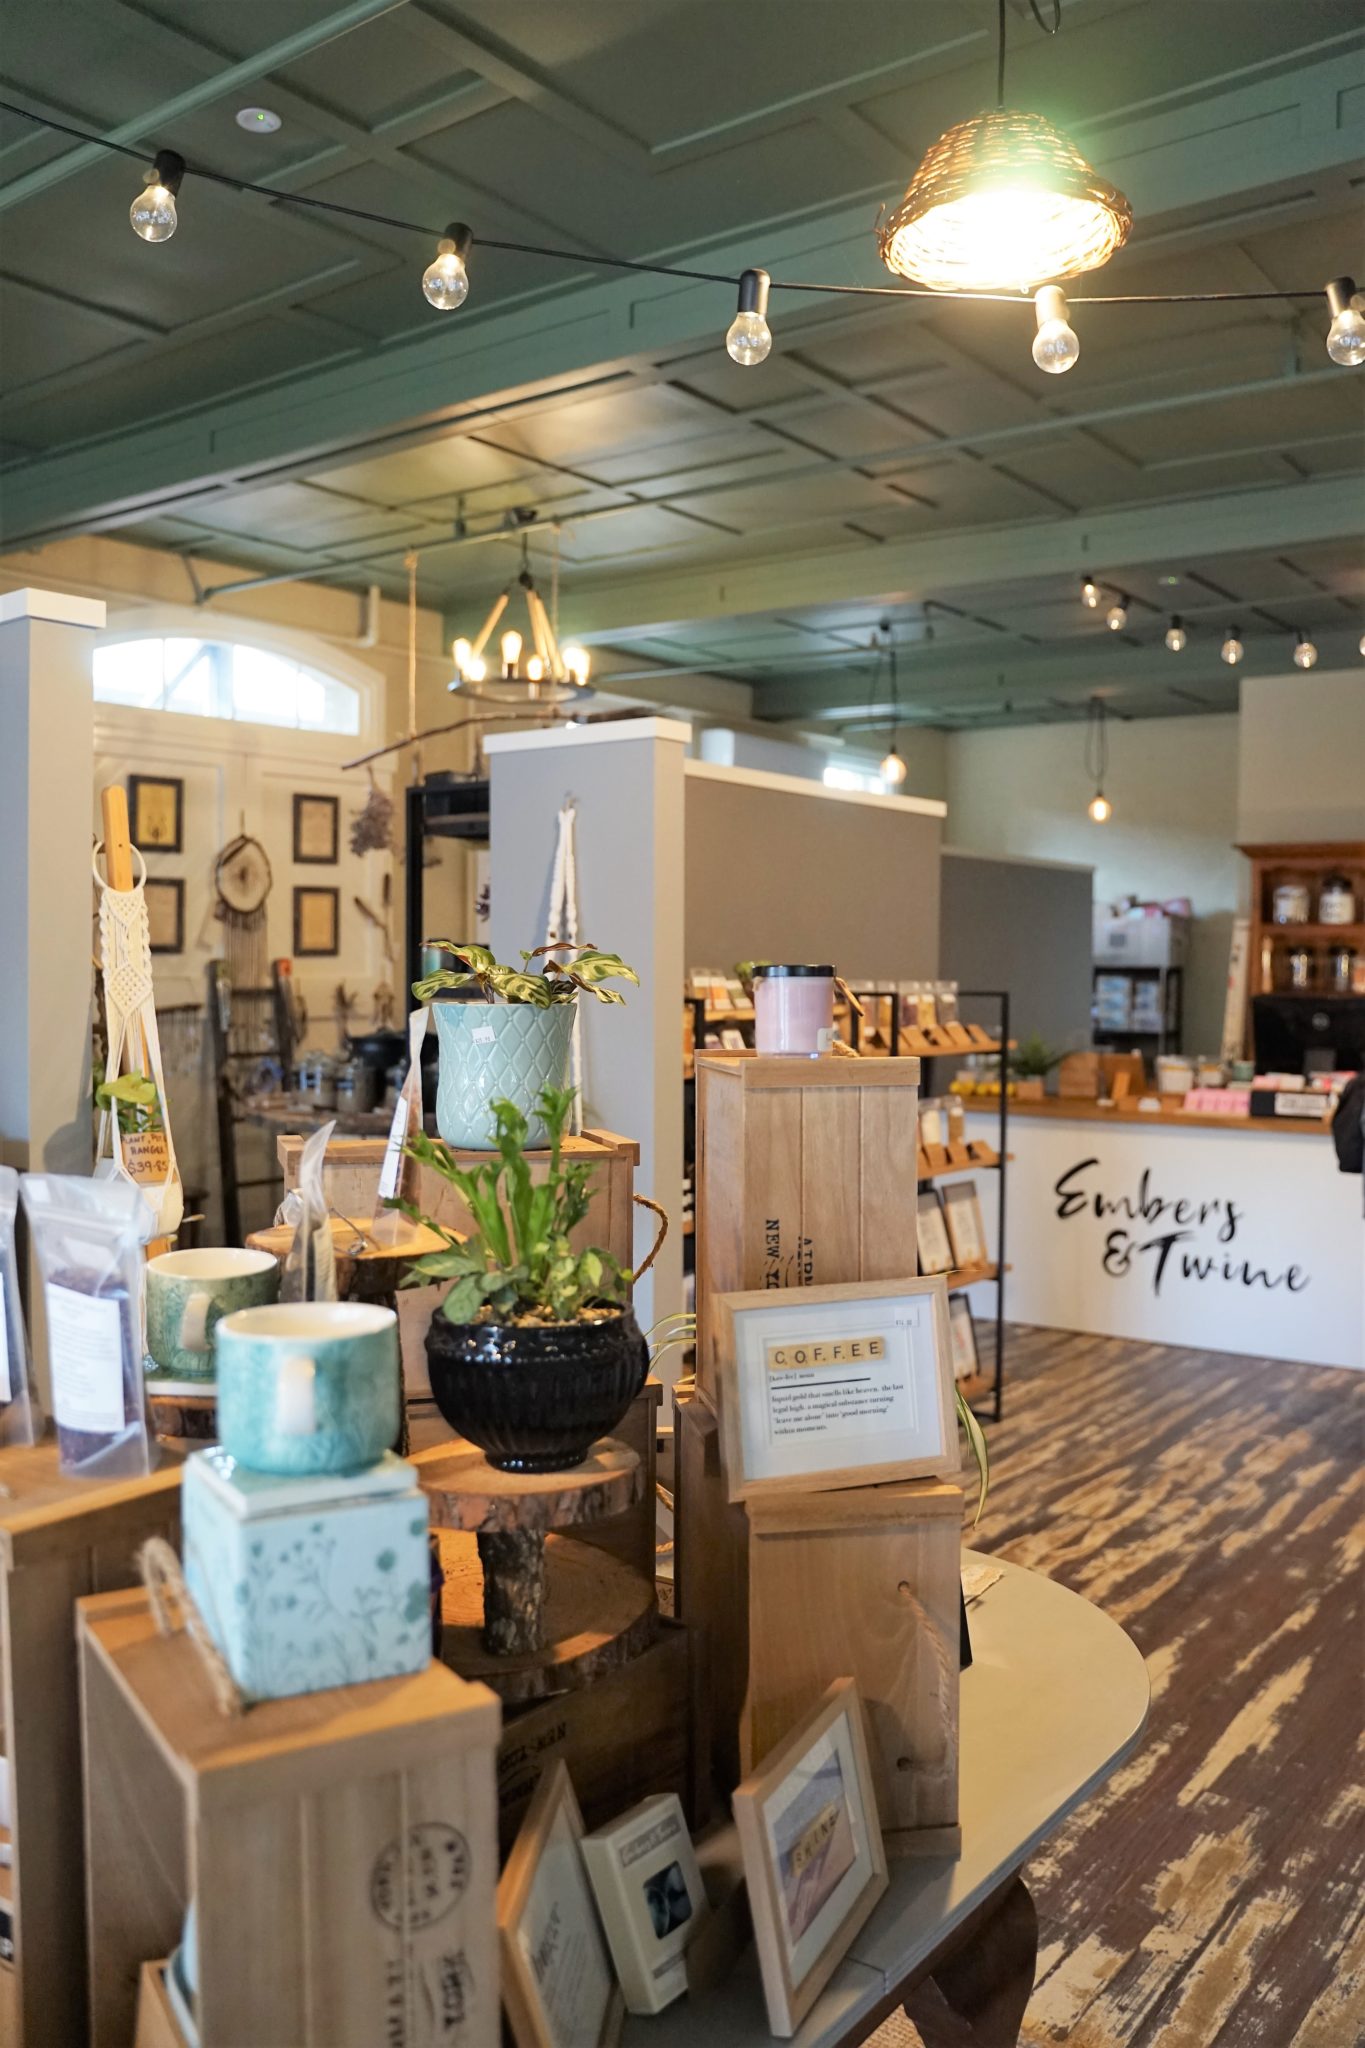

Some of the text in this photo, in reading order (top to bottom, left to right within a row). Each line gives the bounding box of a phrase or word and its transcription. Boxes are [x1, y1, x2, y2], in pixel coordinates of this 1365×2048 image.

[1054, 1157, 1244, 1242] Embers
[765, 1218, 780, 1259] NEW
[1102, 1229, 1312, 1297] & Twine
[773, 1340, 880, 1365] COFFEE
[792, 1392, 807, 1402] gold
[808, 1391, 820, 1399] that
[843, 1387, 854, 1396] like
